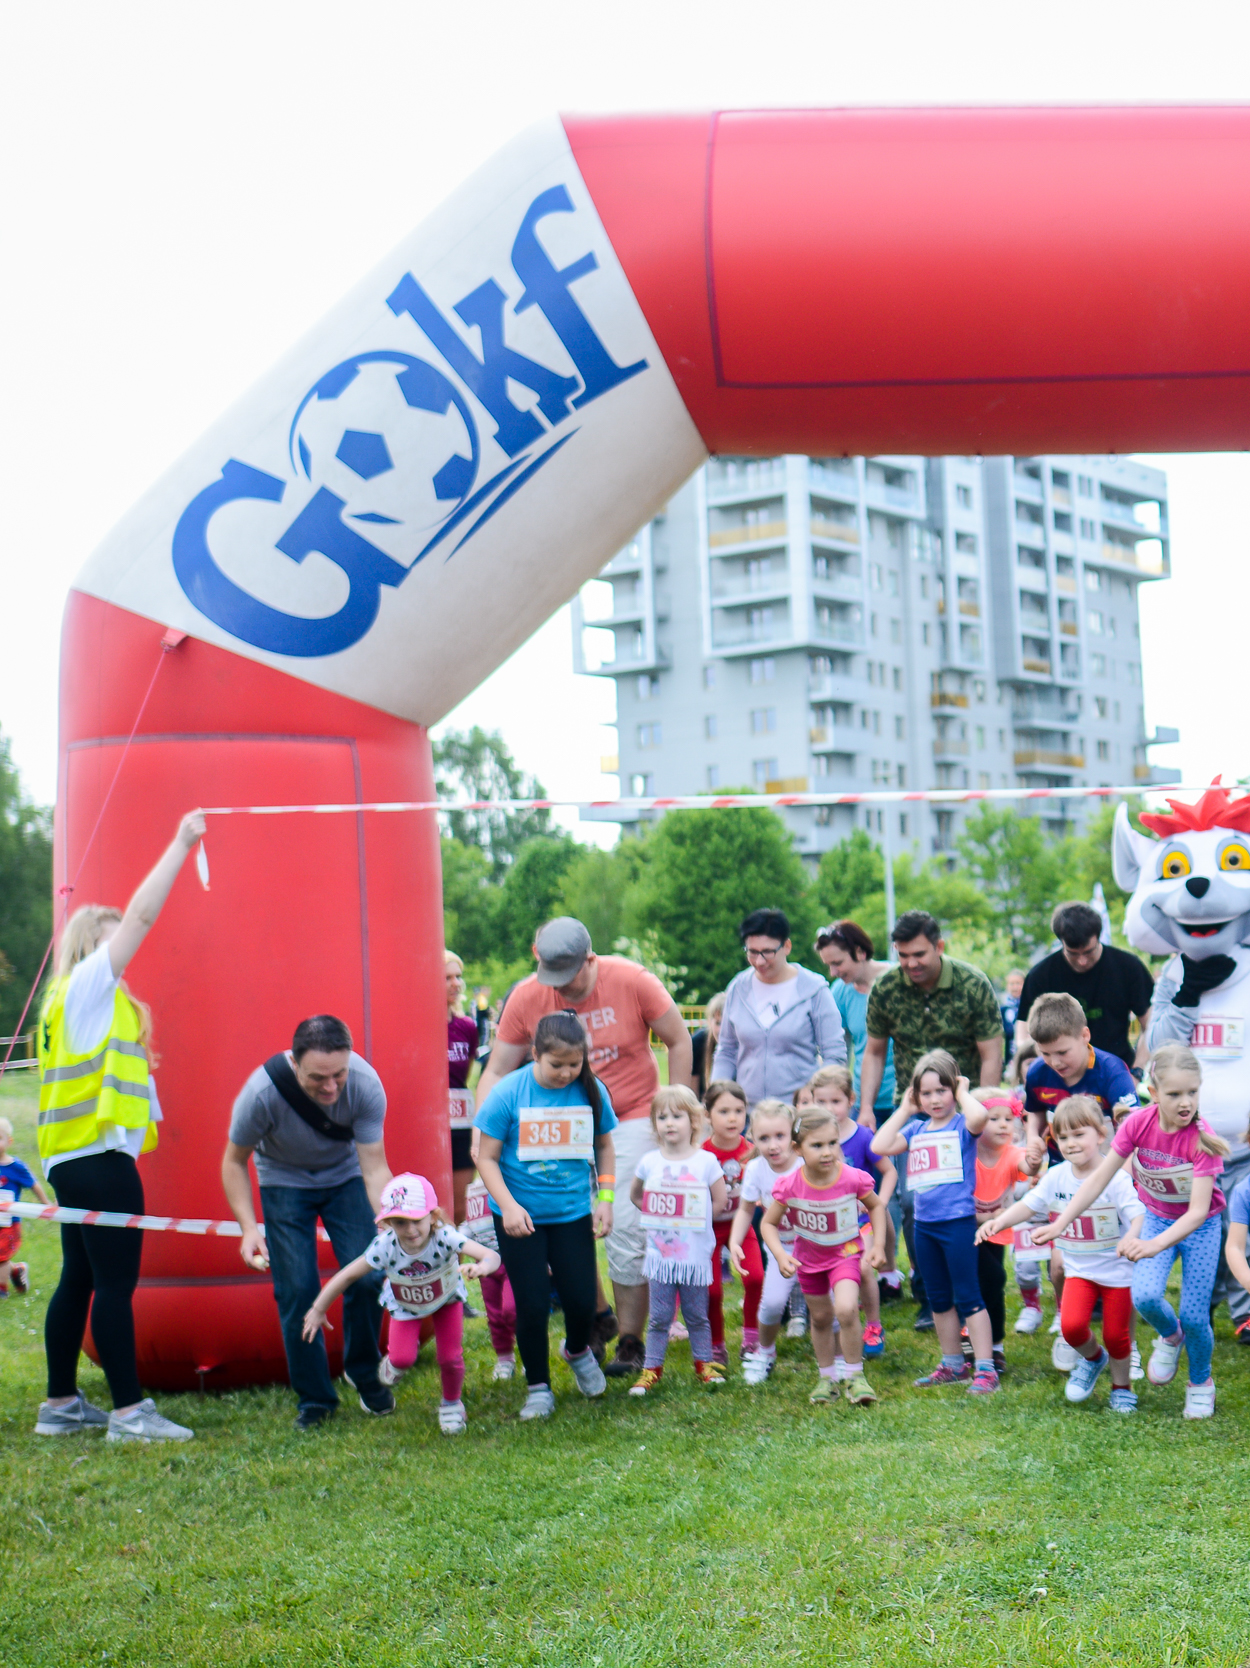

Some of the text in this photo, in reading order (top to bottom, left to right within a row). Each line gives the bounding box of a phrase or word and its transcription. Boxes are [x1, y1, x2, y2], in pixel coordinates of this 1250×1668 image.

[450, 1100, 463, 1117] 65
[529, 1122, 562, 1144] 345
[909, 1148, 931, 1173] 029
[1138, 1173, 1167, 1193] 028
[649, 1192, 677, 1216] 069
[797, 1210, 828, 1232] 098
[1061, 1218, 1084, 1238] 41
[400, 1285, 435, 1303] 066
